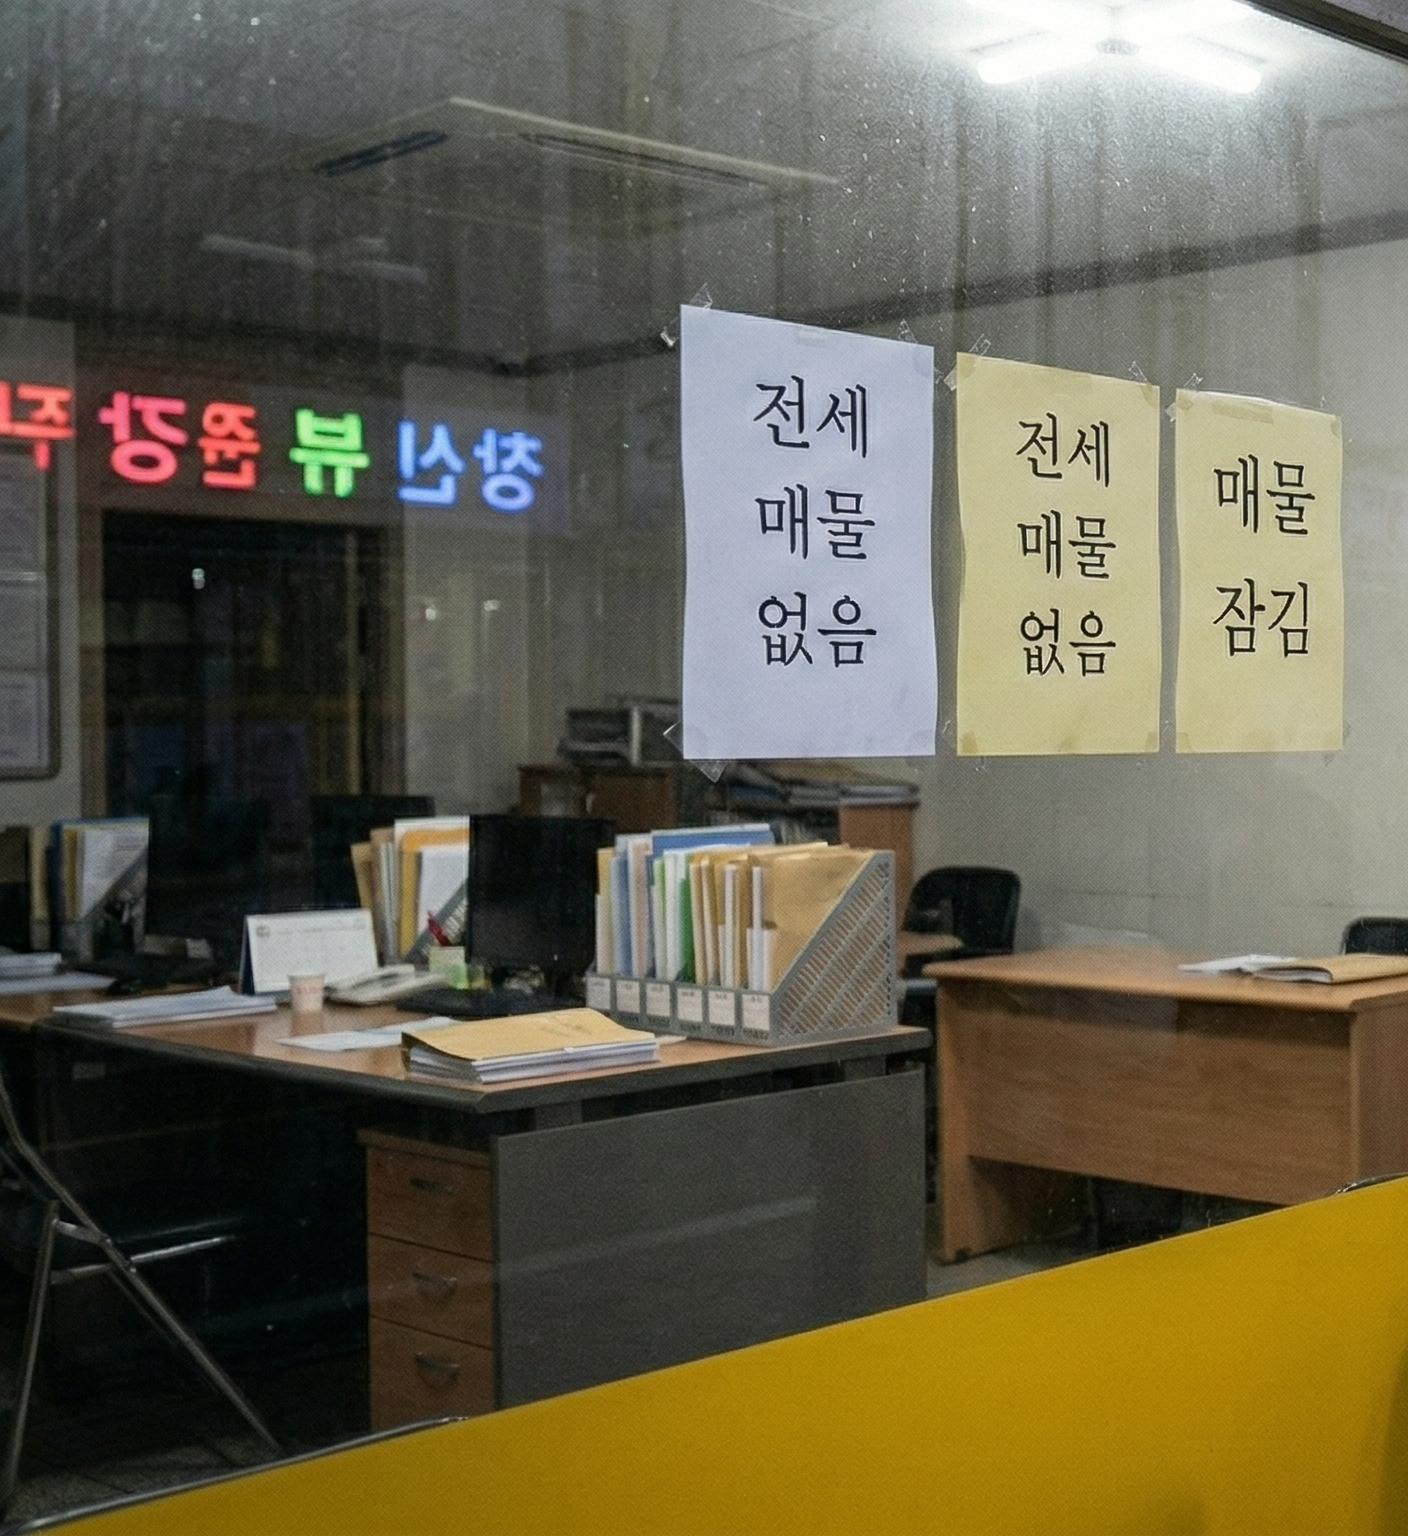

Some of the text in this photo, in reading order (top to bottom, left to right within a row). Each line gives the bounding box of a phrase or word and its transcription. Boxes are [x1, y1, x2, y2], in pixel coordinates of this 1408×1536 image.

[753, 375, 868, 459] 전세
[1016, 412, 1111, 488] 전세
[754, 483, 876, 560] 매물
[1213, 454, 1316, 535] 매물
[1017, 509, 1118, 579] 매물
[758, 591, 877, 668] 없음
[1019, 608, 1117, 677] 없음
[1212, 578, 1310, 658] 잠김
